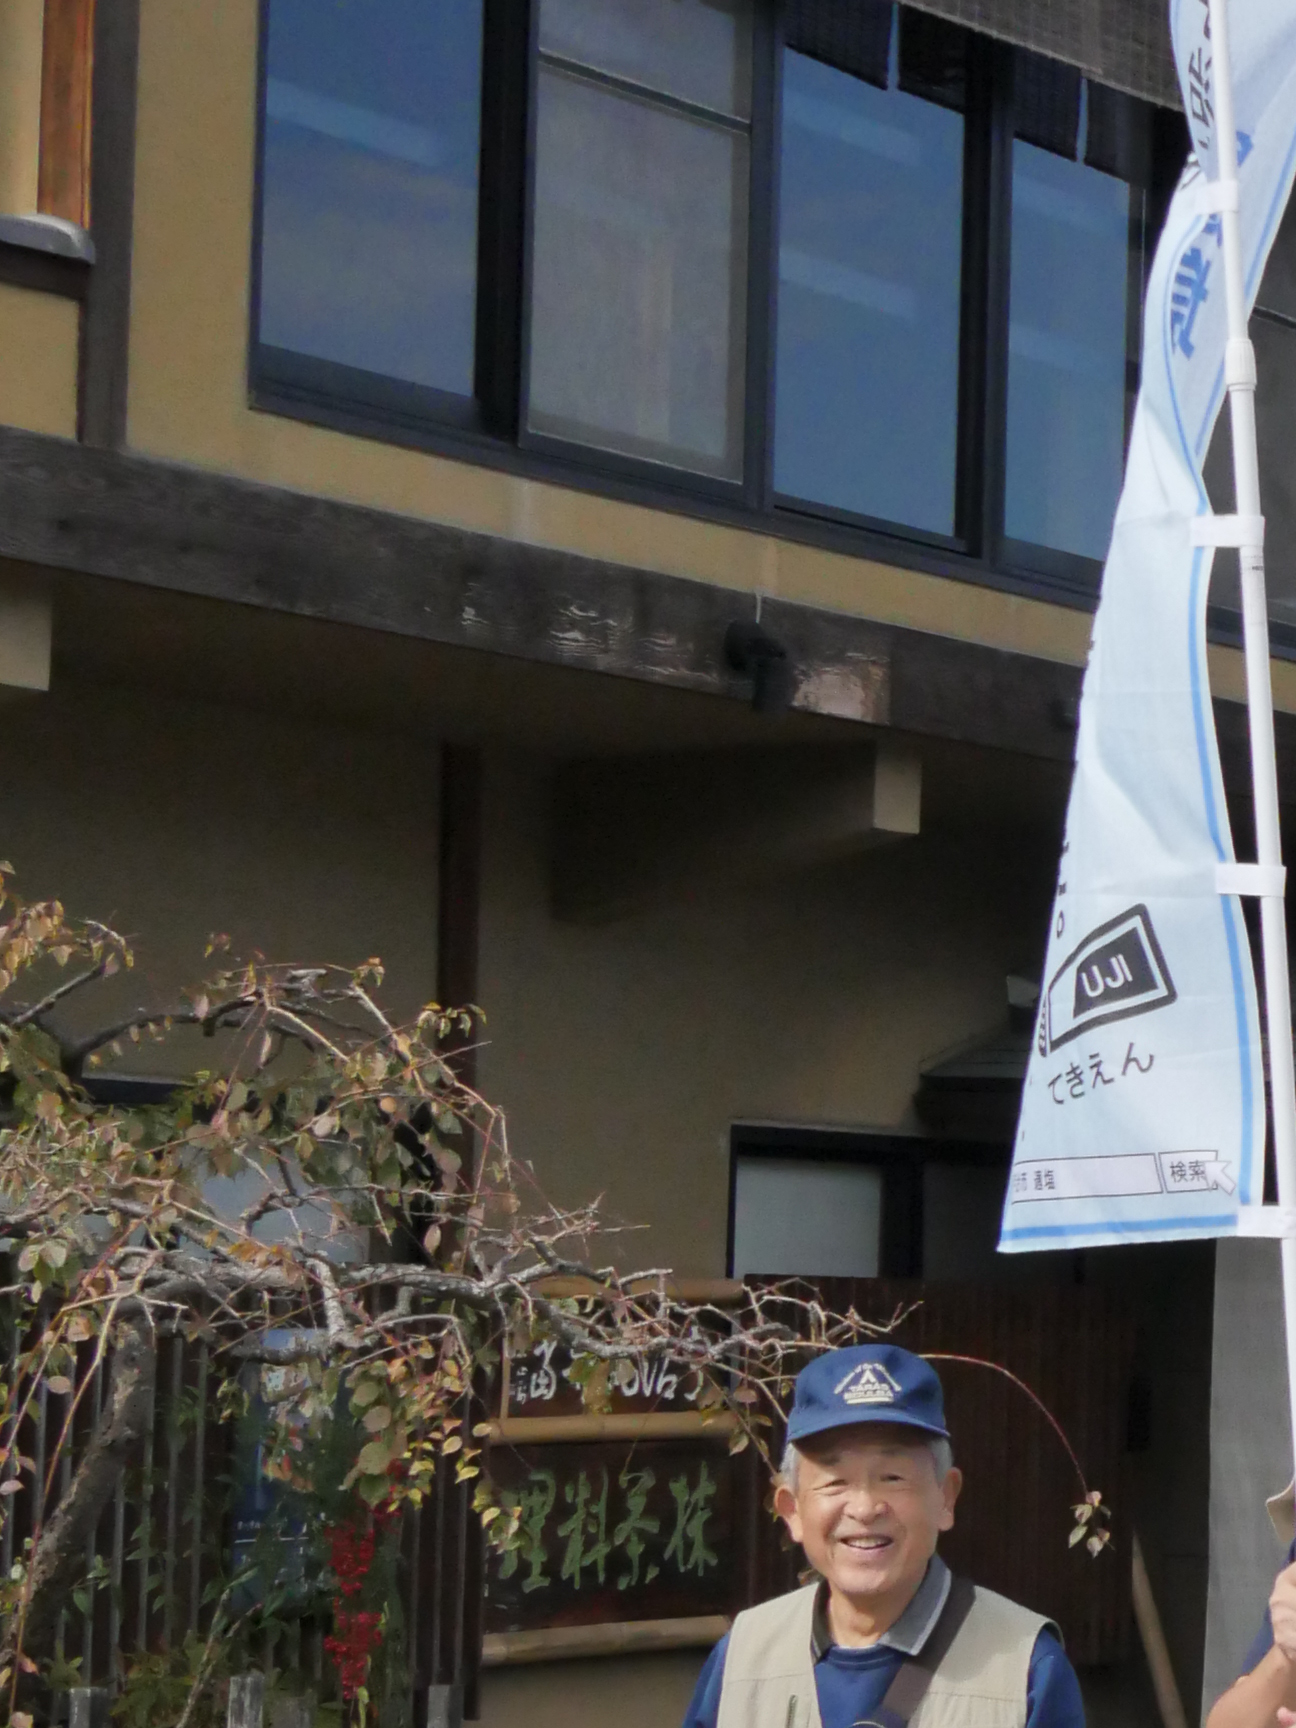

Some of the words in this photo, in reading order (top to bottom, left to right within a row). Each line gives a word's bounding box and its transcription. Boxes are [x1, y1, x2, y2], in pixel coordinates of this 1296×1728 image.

[1080, 953, 1133, 998] UJI
[1047, 1042, 1154, 1105] てきえん
[1169, 1160, 1206, 1184] 検索
